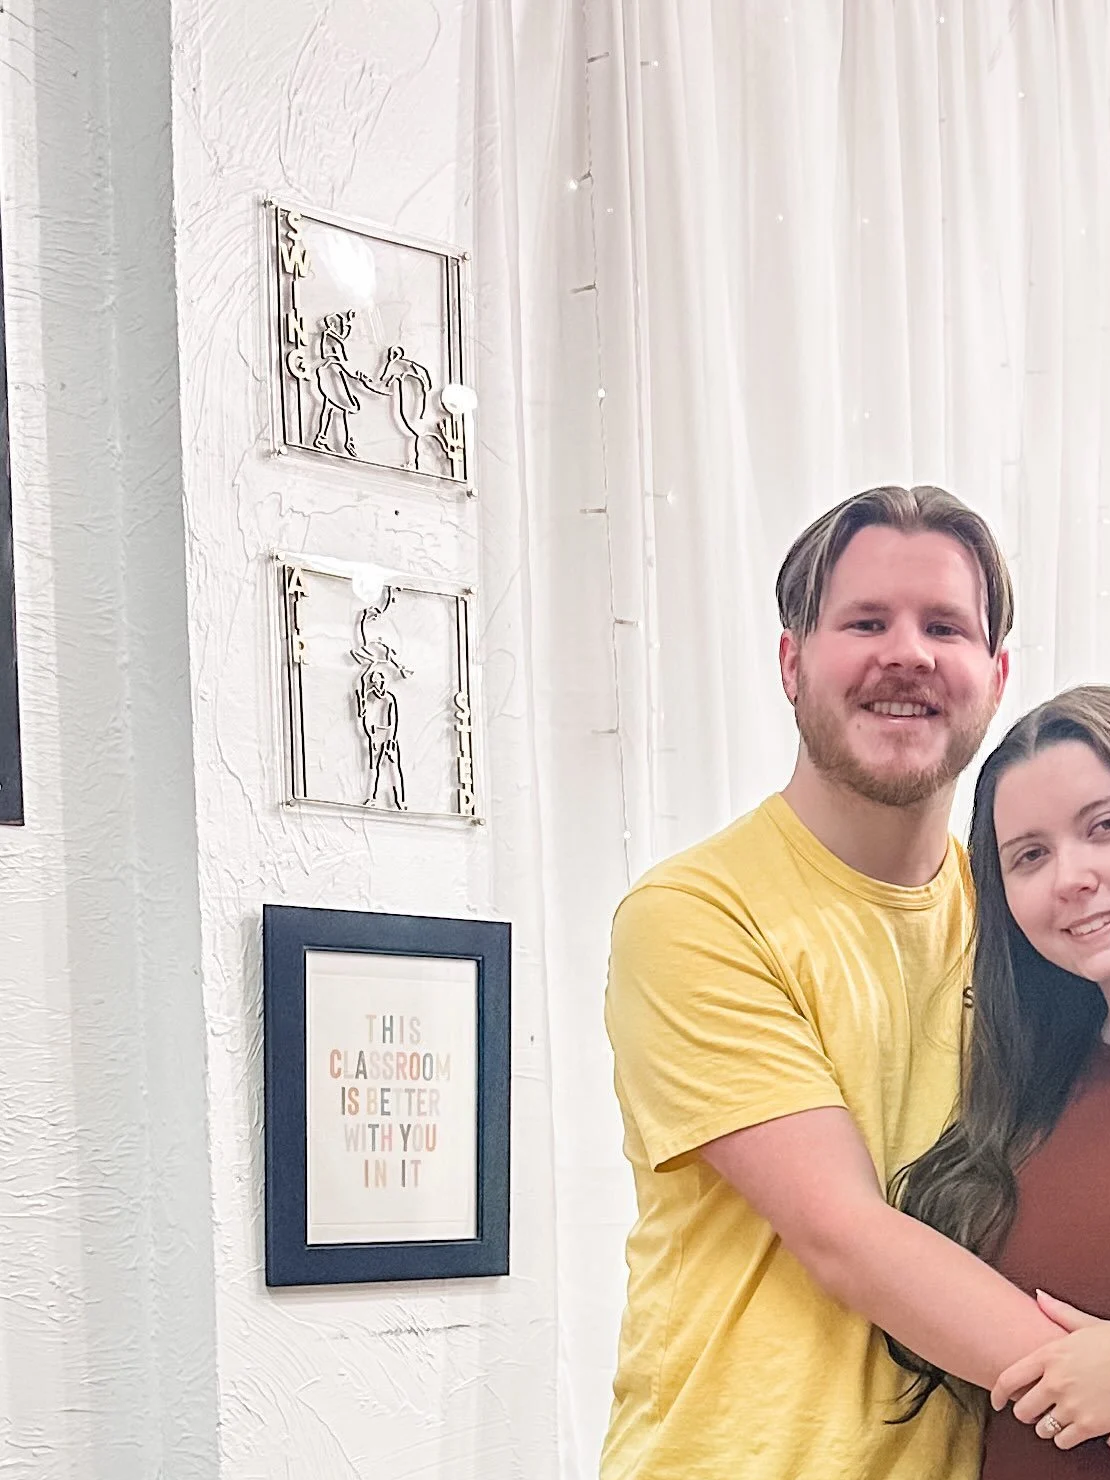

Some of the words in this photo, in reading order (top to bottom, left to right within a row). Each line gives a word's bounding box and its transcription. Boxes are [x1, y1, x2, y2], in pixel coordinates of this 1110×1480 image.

[281, 209, 311, 382] SWING
[365, 1014, 421, 1045] THIS
[329, 1048, 451, 1081] CLASSROOM
[341, 1086, 360, 1116] IS
[366, 1087, 441, 1117] BETTER
[344, 1123, 393, 1152] WITH
[399, 1123, 437, 1152] YOU
[364, 1159, 387, 1188] IN
[401, 1159, 422, 1188] IT
